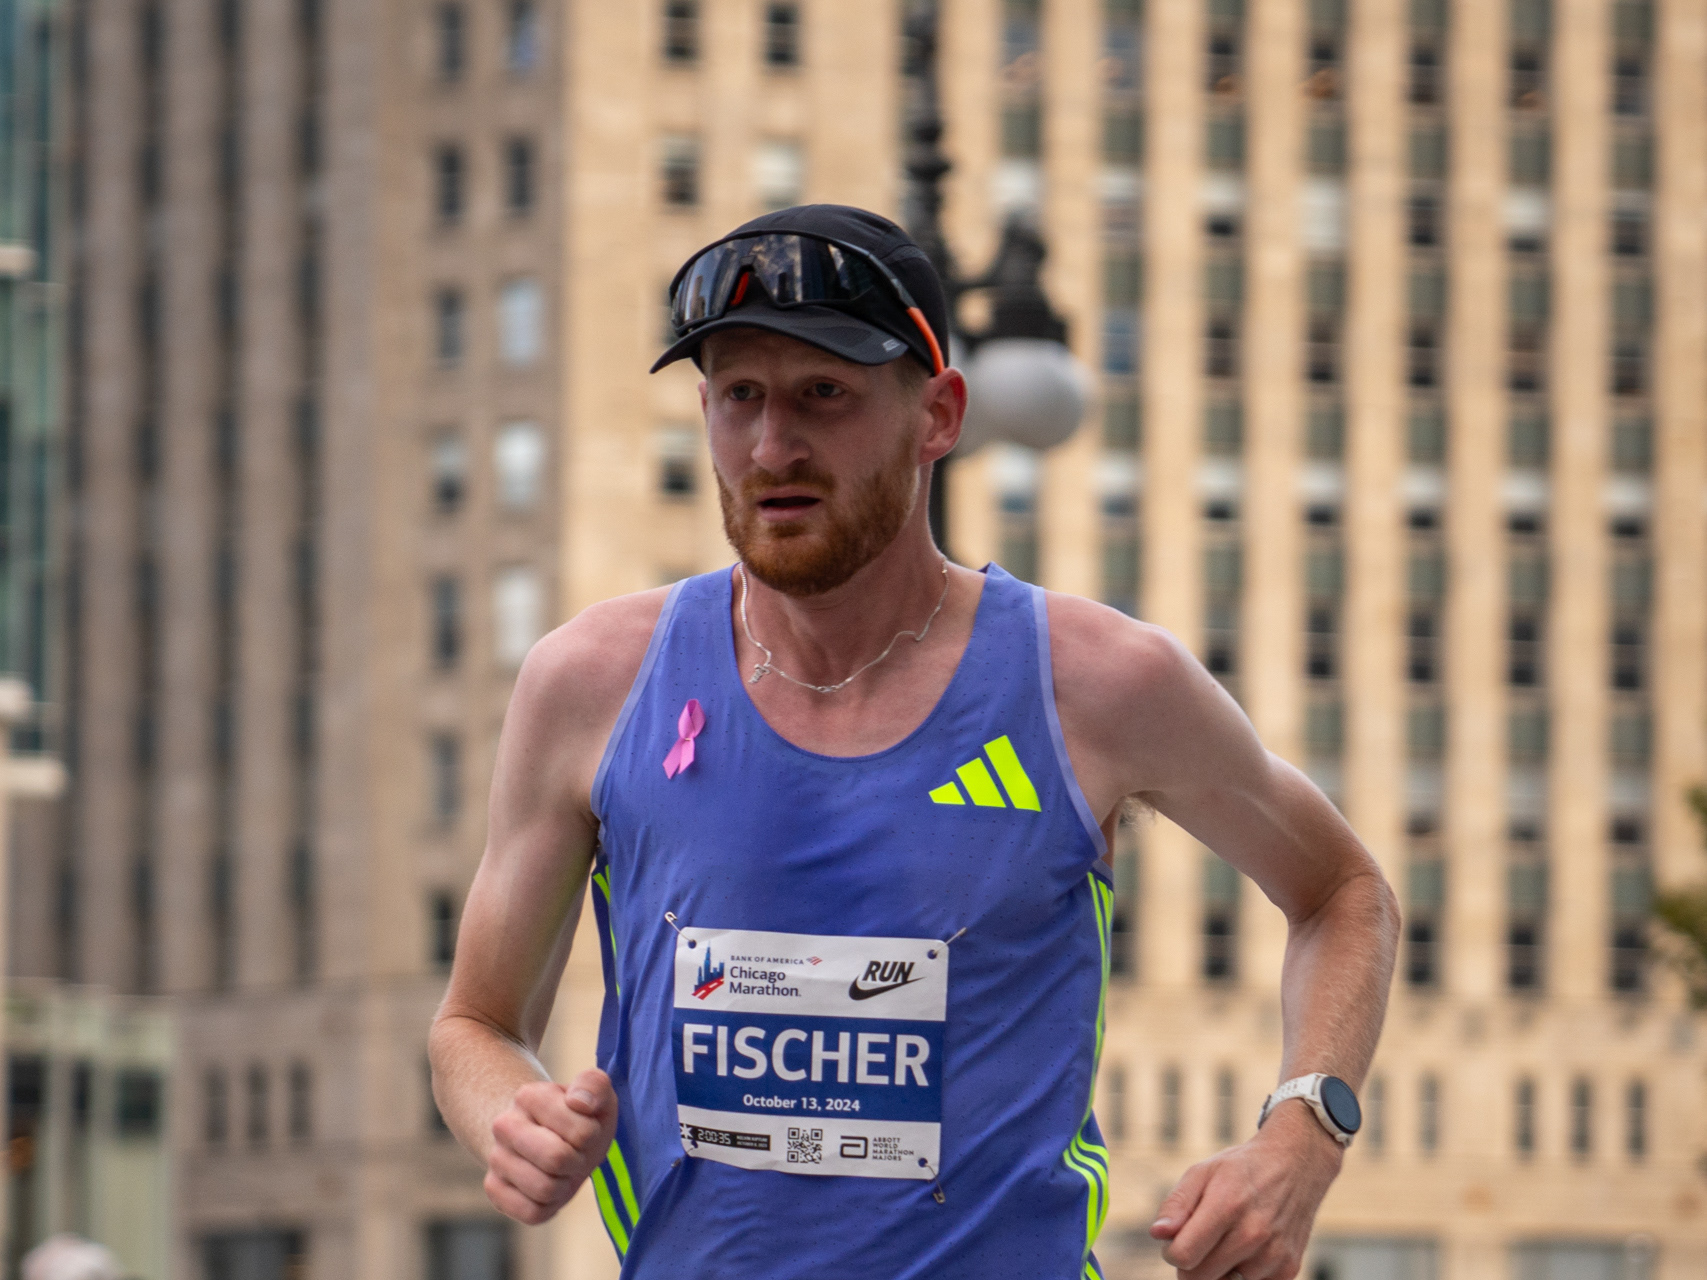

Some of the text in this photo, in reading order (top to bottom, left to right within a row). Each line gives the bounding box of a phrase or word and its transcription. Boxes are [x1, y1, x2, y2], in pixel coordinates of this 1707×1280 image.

[730, 955, 752, 963] BANK
[767, 957, 804, 965] AMERICA
[730, 966, 786, 983] Chicago
[862, 960, 915, 982] RUN
[683, 1023, 930, 1087] FISCHER
[743, 1094, 860, 1112] October 13, 2024
